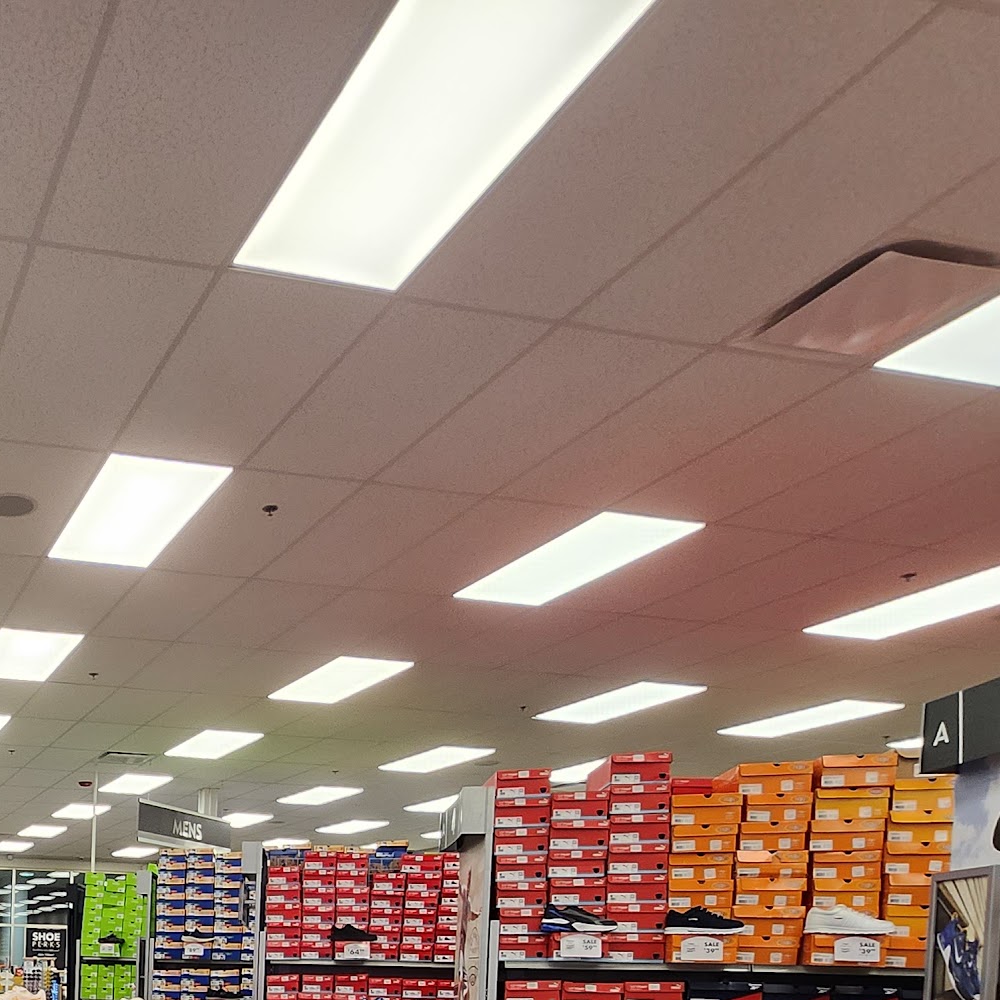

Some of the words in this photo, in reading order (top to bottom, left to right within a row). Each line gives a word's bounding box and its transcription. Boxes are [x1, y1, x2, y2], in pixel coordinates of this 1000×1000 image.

[932, 721, 950, 747] A
[172, 818, 203, 841] MENS
[32, 931, 61, 942] SHOE
